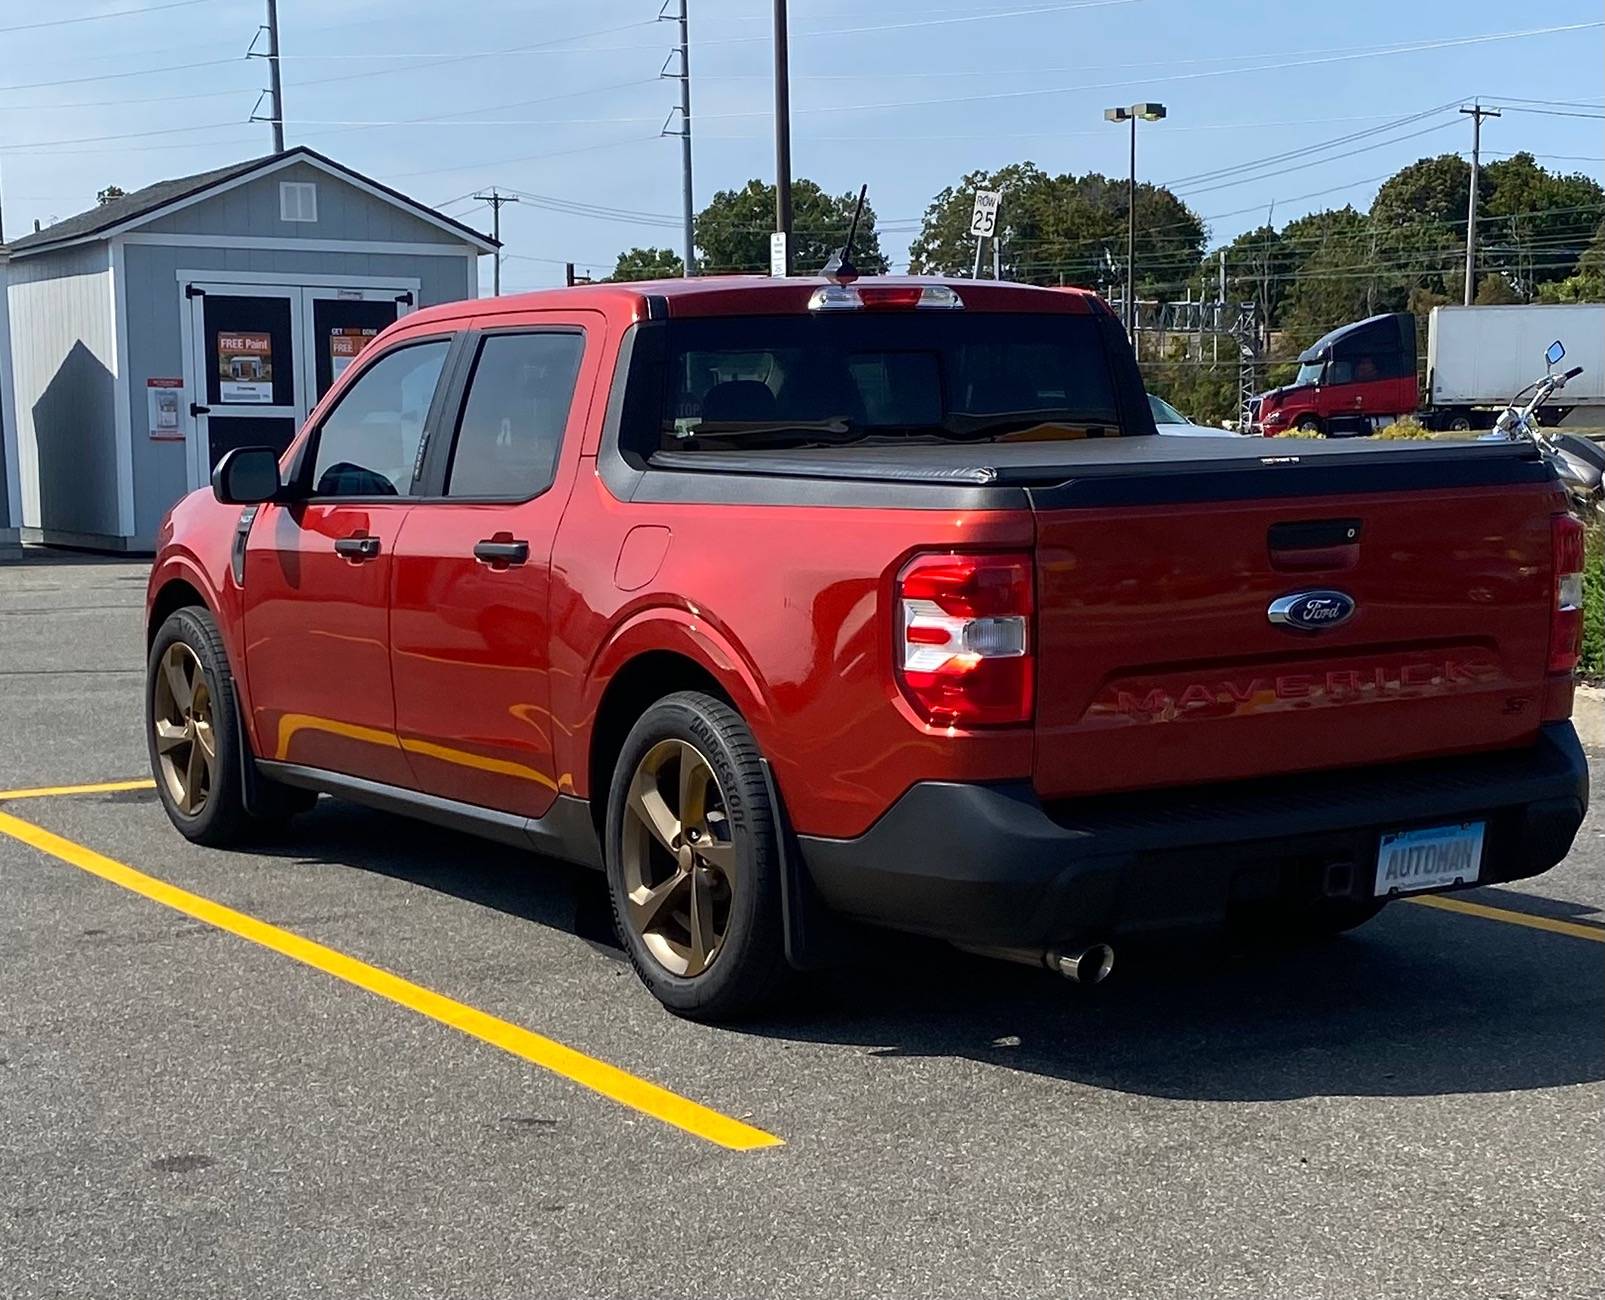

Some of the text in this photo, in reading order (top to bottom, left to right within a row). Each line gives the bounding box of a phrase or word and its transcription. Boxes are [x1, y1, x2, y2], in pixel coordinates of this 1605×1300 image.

[973, 210, 994, 232] 25
[220, 338, 268, 350] FREE Paint
[333, 343, 354, 353] FREE
[1302, 599, 1341, 621] Ford
[1117, 660, 1478, 712] MAVERICK
[689, 715, 747, 834] BRIDGESTONE
[1385, 839, 1472, 881] AUTOMAN
